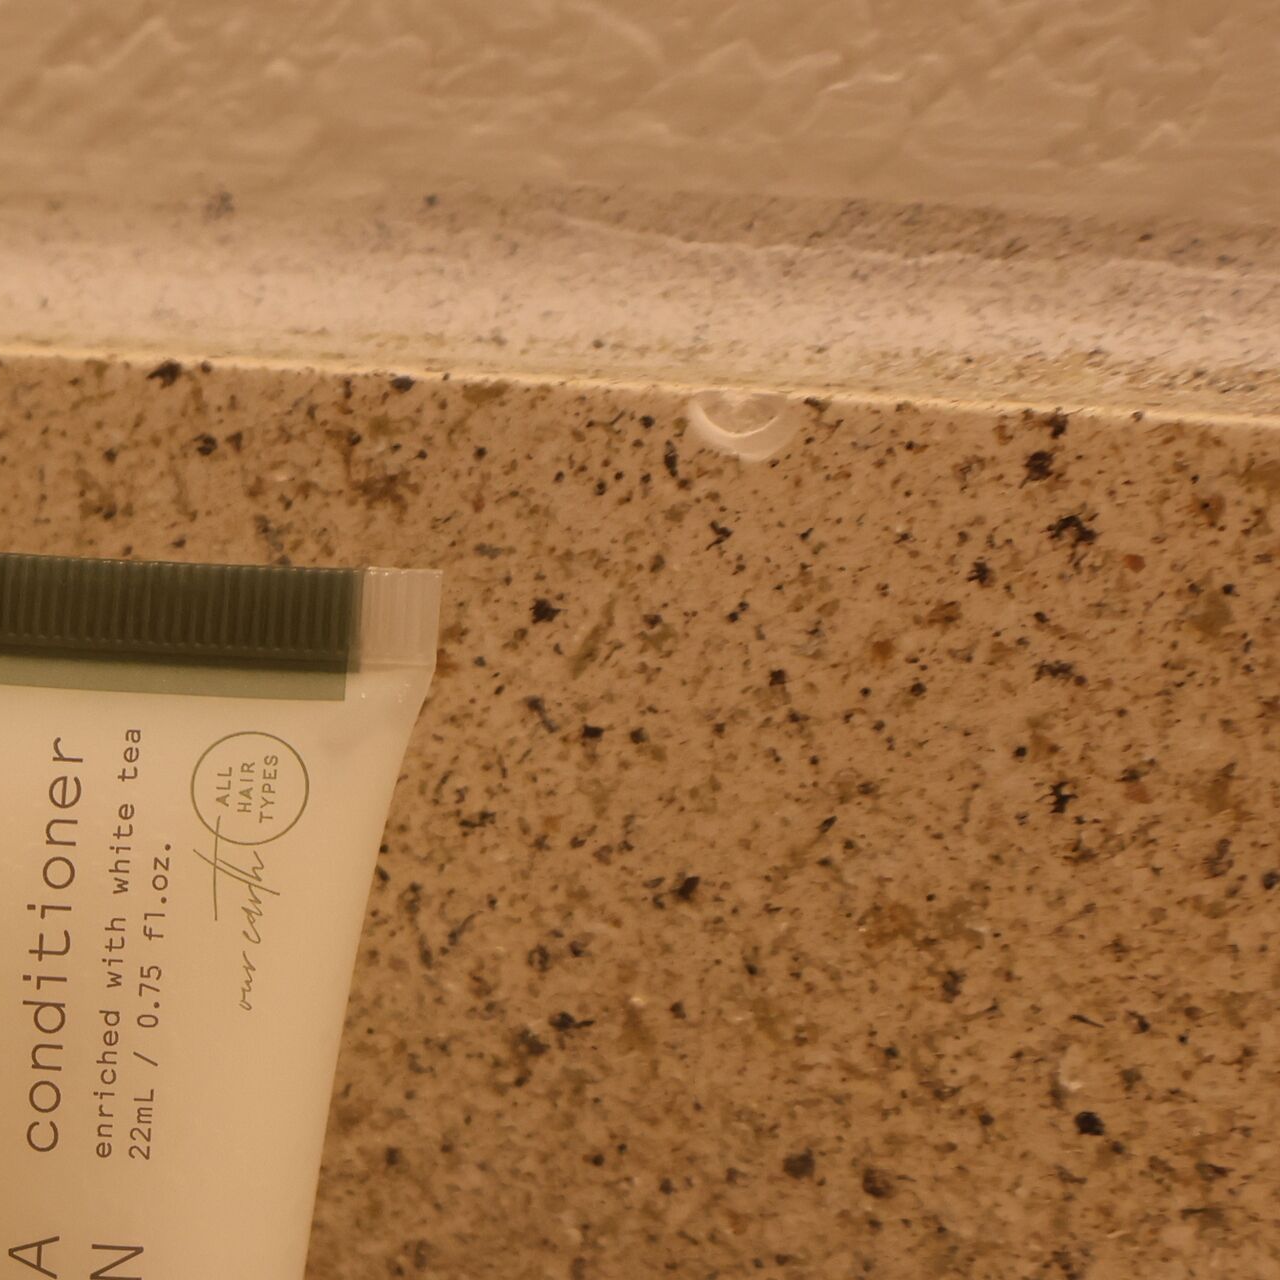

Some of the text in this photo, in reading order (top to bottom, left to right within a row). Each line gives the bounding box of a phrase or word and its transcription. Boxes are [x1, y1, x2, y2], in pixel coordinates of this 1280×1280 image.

[216, 766, 232, 807] ALL
[237, 762, 255, 813] HAIR
[260, 754, 279, 823] TYPES
[21, 736, 84, 1153] conditioner
[92, 728, 141, 1159] enriched with white tea
[129, 843, 171, 1161] 22mL / 0.75 fl.oz.
